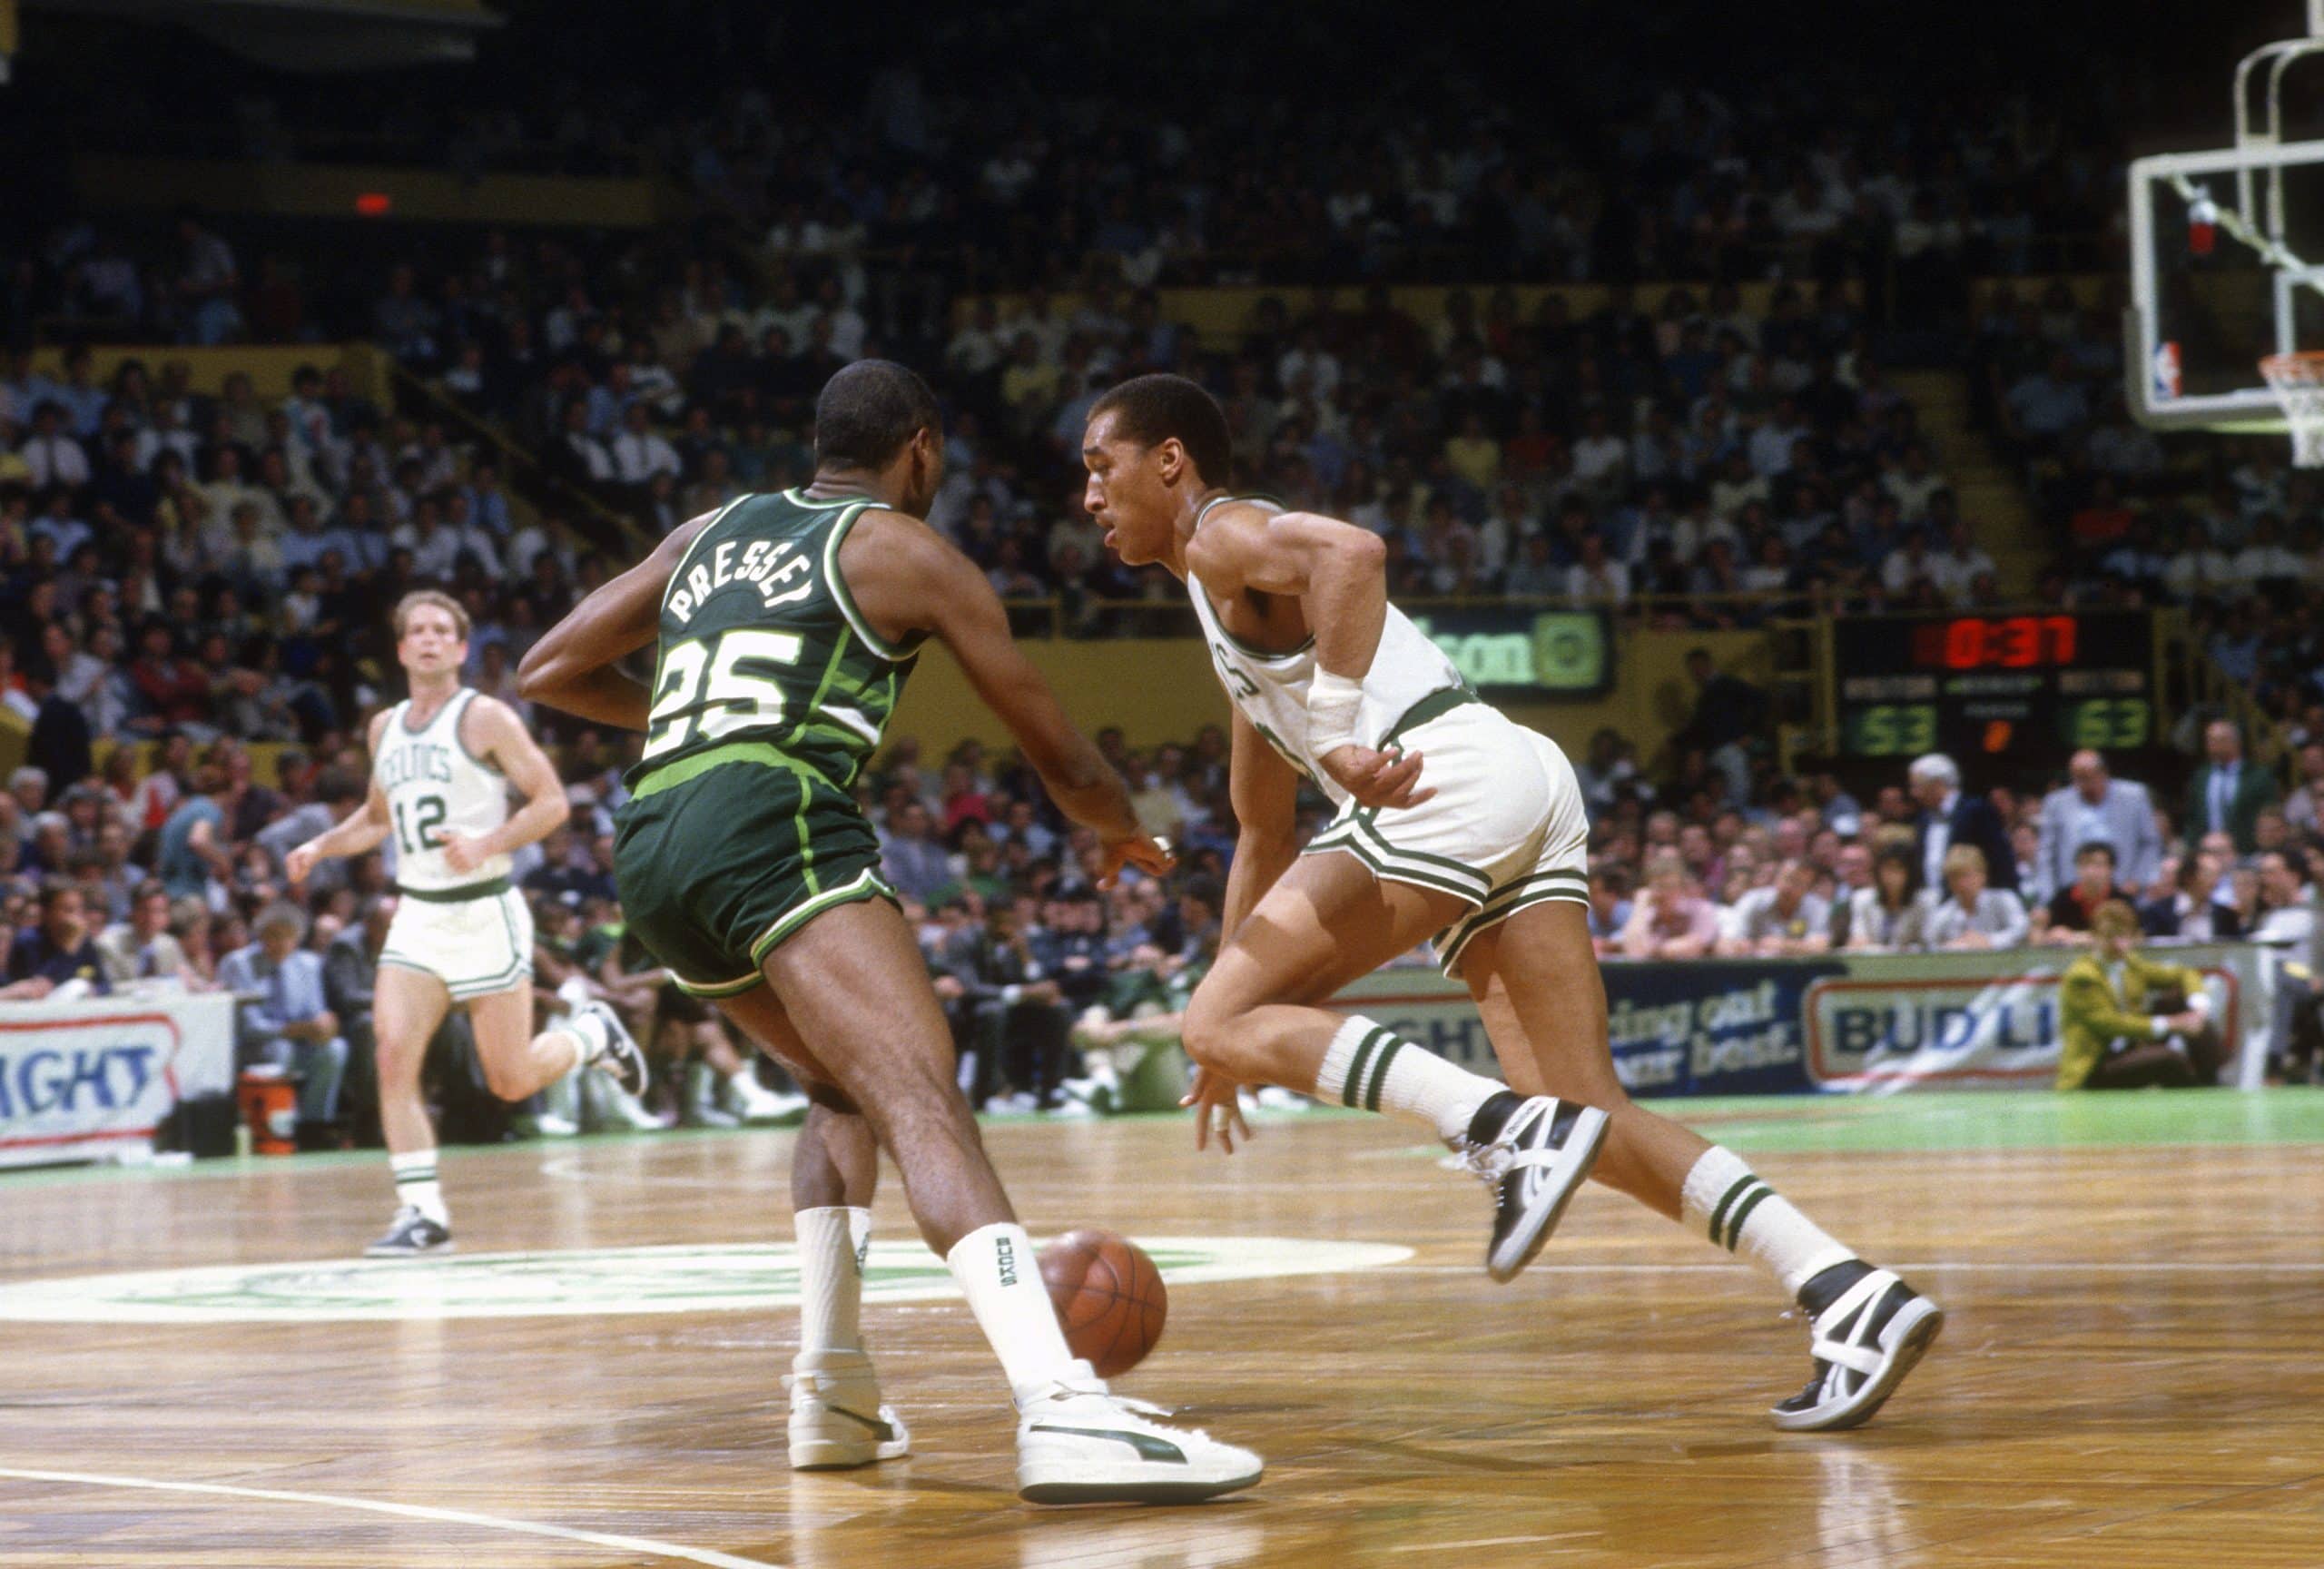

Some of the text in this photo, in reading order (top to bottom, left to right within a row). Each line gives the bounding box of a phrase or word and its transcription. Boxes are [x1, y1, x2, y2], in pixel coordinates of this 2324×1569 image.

[1946, 616, 2076, 668] 0:37
[642, 629, 804, 761] 25
[396, 794, 448, 854] 12
[1835, 1008, 1979, 1053] BUD
[996, 1237, 1018, 1287] BUCKS
